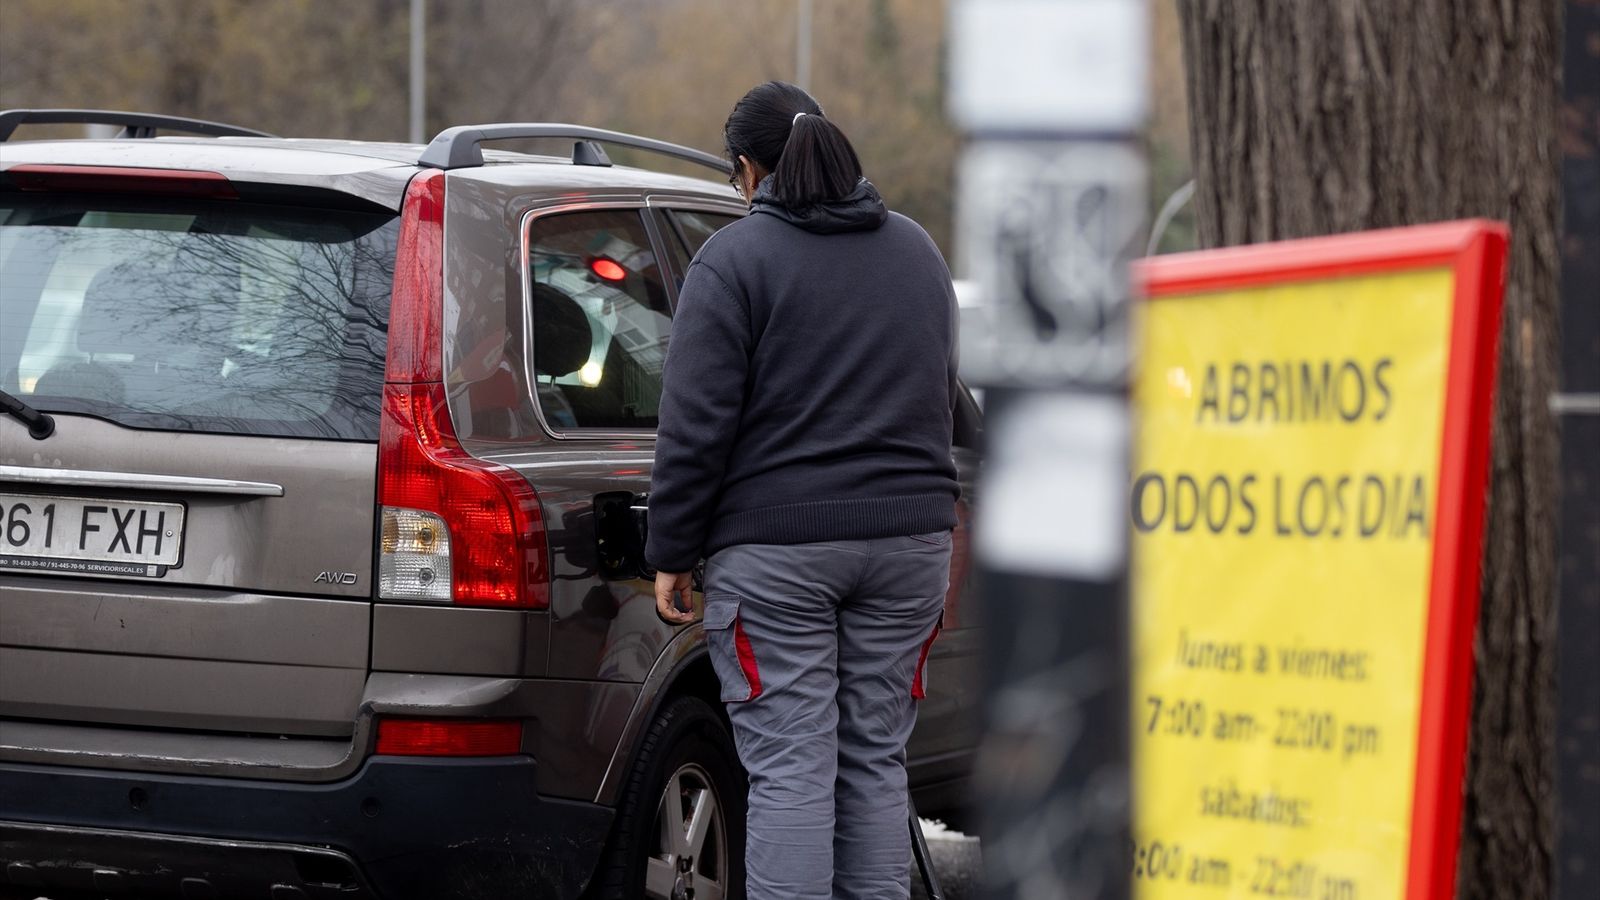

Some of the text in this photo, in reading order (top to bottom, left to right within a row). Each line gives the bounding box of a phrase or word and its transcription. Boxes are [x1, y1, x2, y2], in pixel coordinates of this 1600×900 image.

[1196, 357, 1394, 425] ABRIMOS
[0, 502, 165, 556] 61 FXH
[1130, 472, 1430, 539] ODOS LOS DIA
[87, 564, 144, 574] SERVICIORISCAL.ES
[313, 571, 357, 585] AWD
